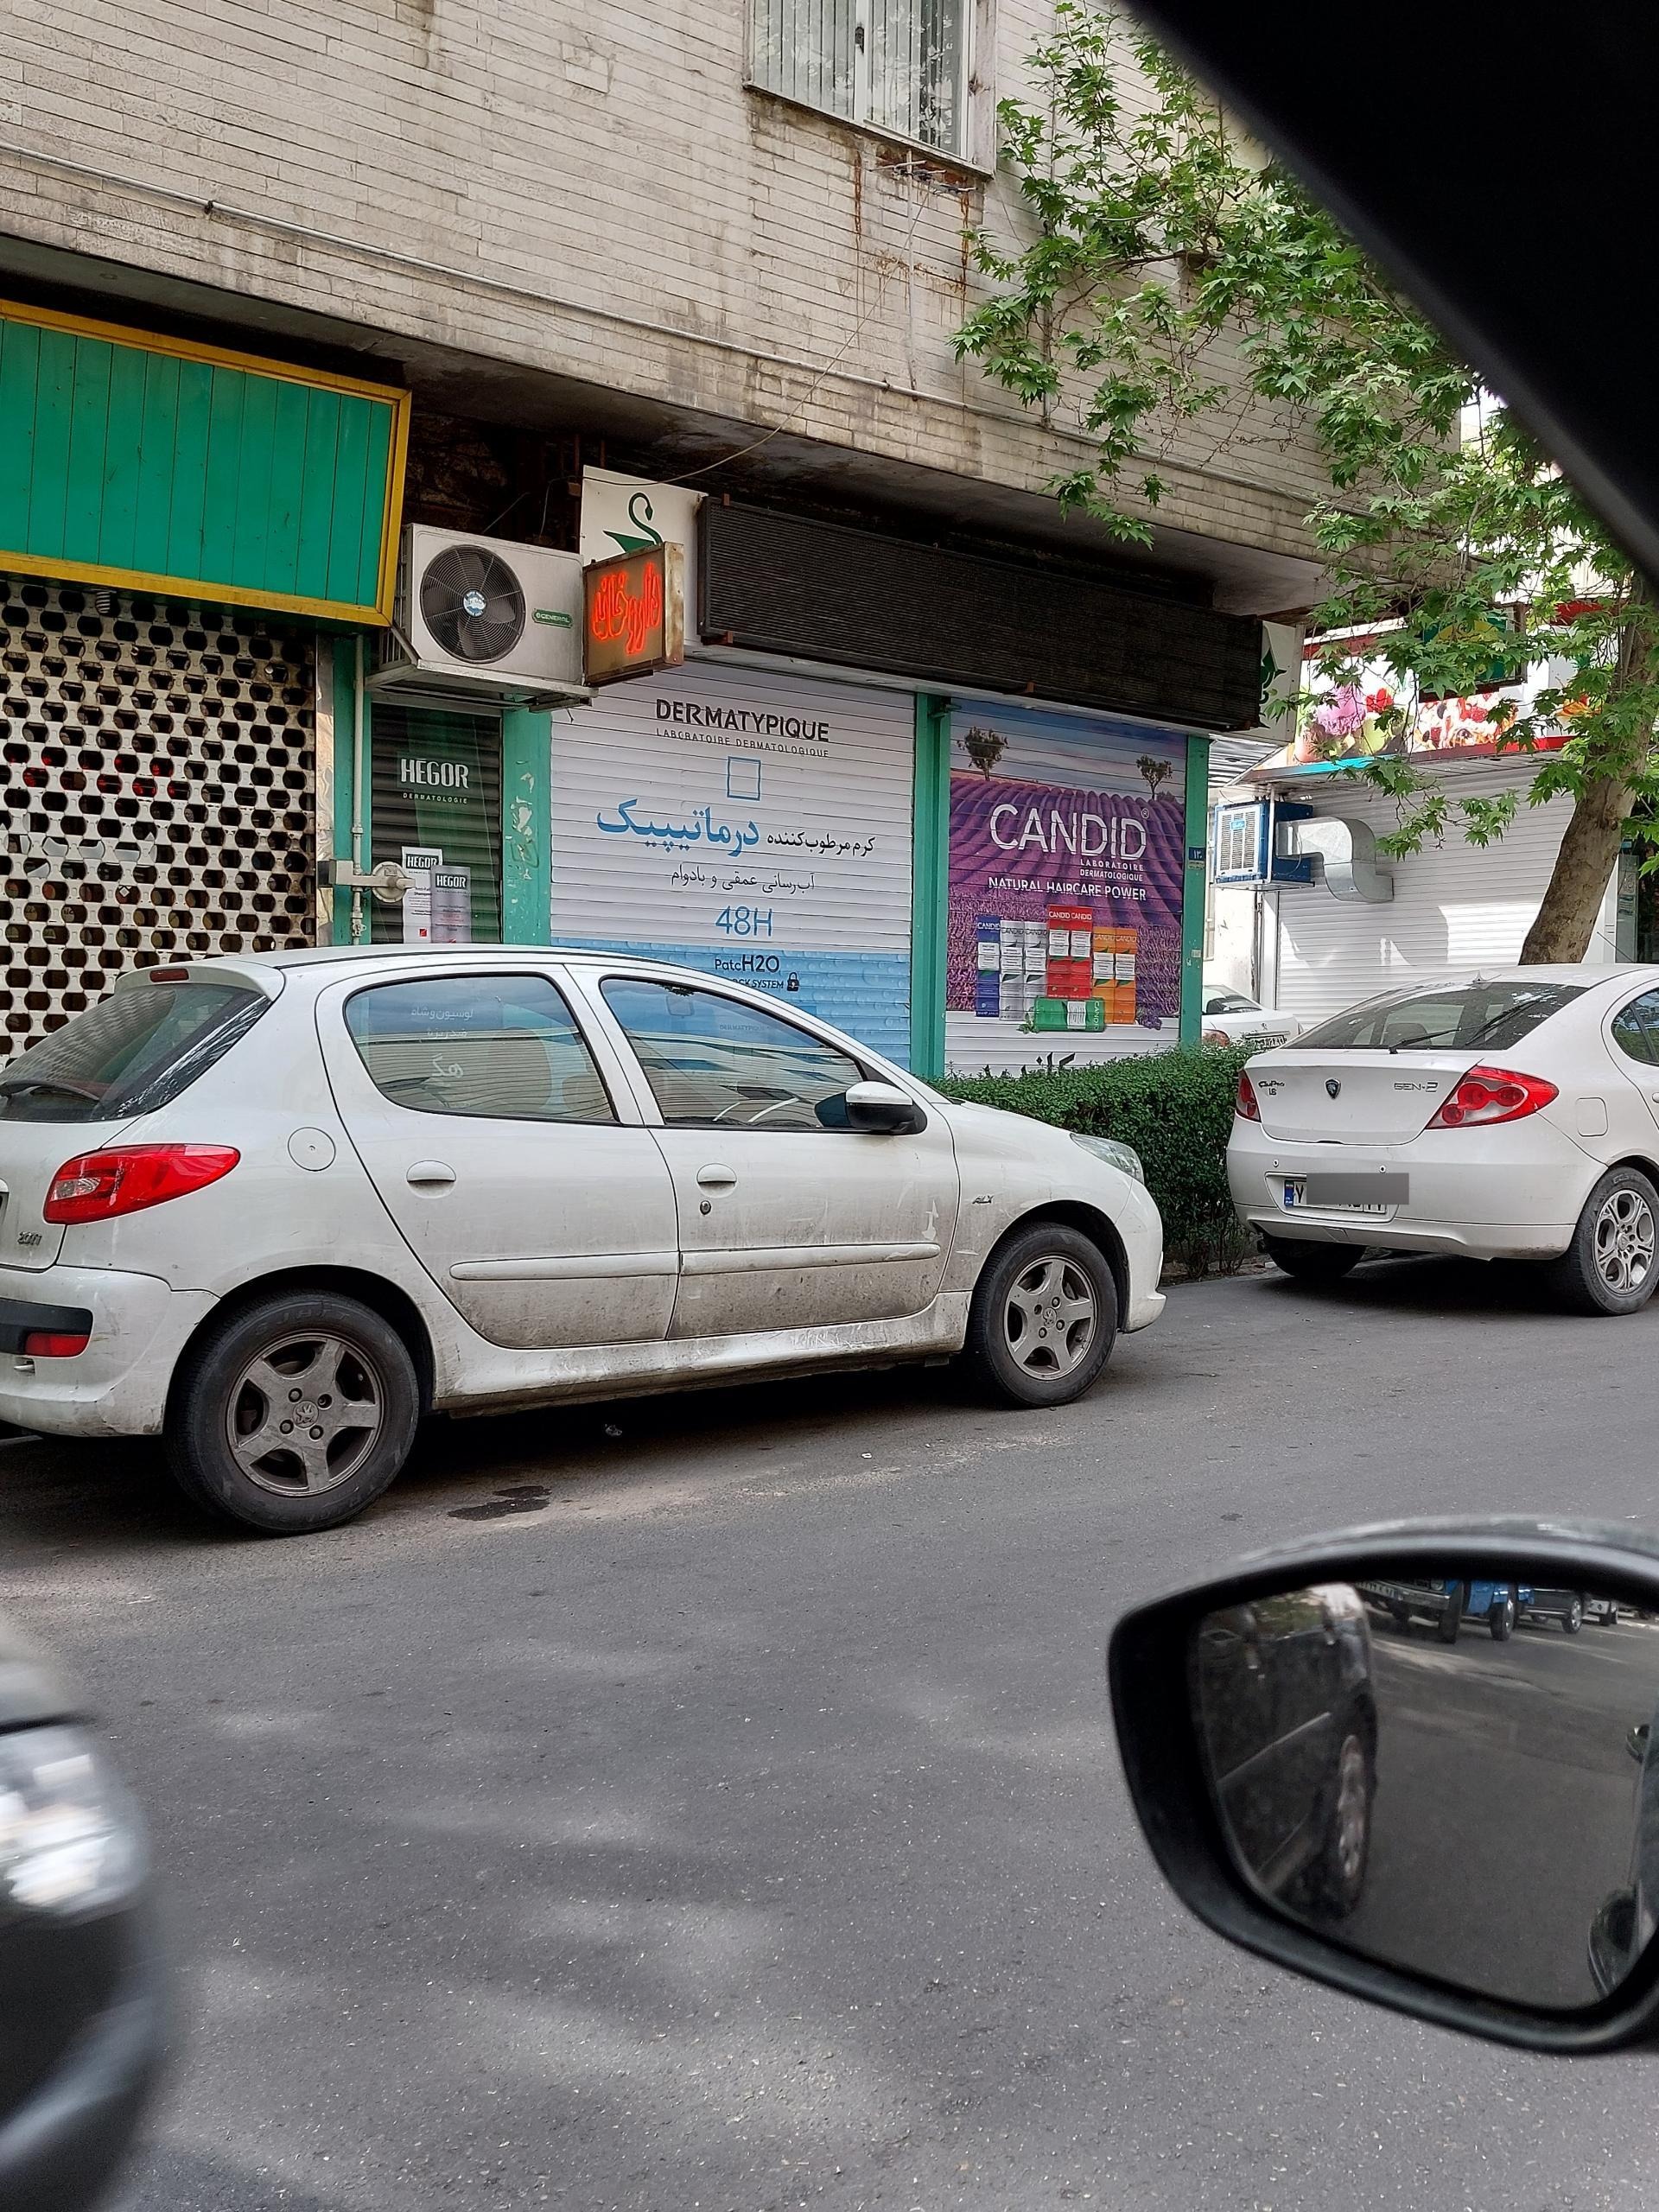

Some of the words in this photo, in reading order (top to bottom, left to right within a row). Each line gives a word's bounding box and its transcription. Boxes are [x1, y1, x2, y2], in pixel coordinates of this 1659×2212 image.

[591, 561, 662, 655] داروخانه
[656, 698, 830, 742] DERMATYPIQUE
[657, 728, 730, 746] LABORATOIRE
[736, 738, 829, 757] DERMATOLOGIQUE
[403, 792, 467, 804] DERMATOLOGIE
[596, 798, 760, 857] درماتیپیک
[989, 804, 1147, 861] CANDID
[852, 836, 875, 857] کرم
[1080, 859, 1145, 872] LABORATOIRE
[1080, 868, 1143, 882] DERMATOLOGIQUE
[436, 875, 467, 887] HEGOR
[721, 871, 757, 891] عمقی
[988, 876, 1043, 893] NATURAL
[1046, 881, 1102, 897] HAIRCARE
[1104, 886, 1147, 901] POWER
[715, 905, 772, 937] 48H
[1048, 911, 1071, 919] CANDID
[1071, 912, 1092, 920] CANDID
[715, 954, 780, 973] PatcH2O
[752, 979, 785, 989] SYSTEM
